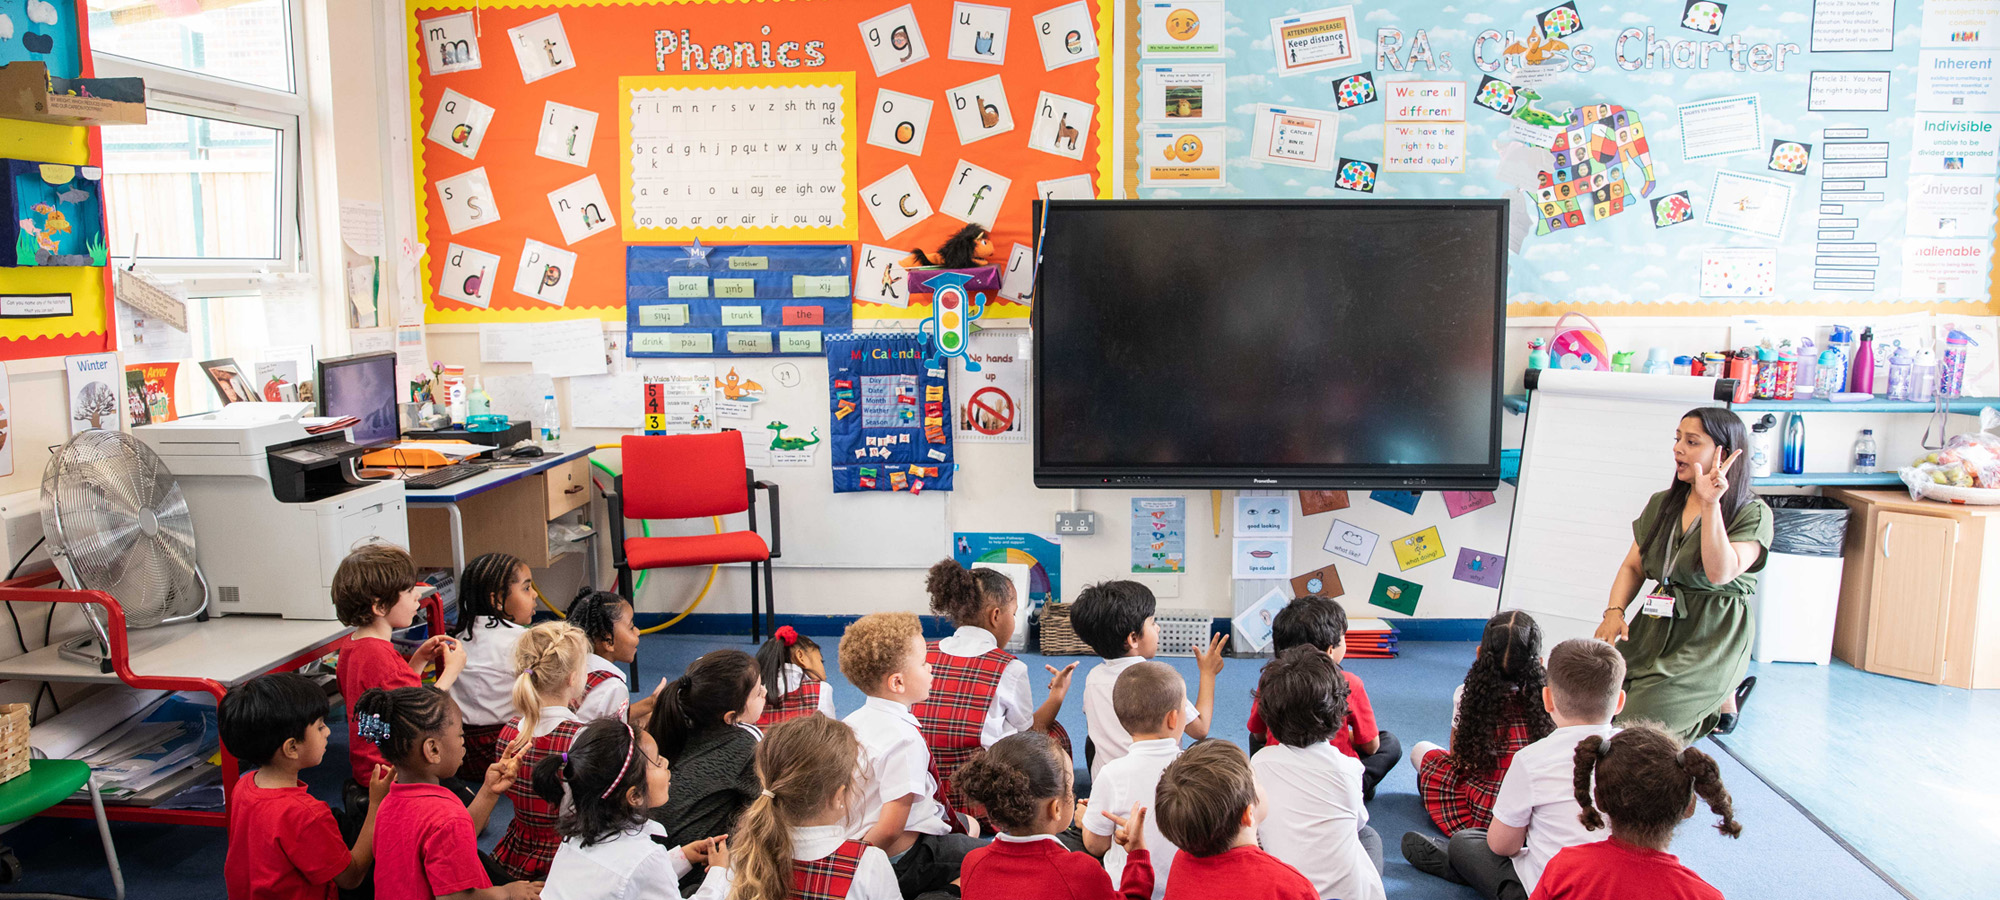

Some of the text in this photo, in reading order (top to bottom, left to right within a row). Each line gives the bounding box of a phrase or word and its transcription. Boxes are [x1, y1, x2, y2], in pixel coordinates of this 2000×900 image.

[959, 11, 971, 26] u
[429, 27, 447, 42] m
[1041, 21, 1052, 35] e
[1287, 22, 1342, 37] ATTENTION PLEASE!
[517, 33, 528, 48] t
[868, 27, 881, 47] g
[1288, 33, 1344, 49] Keep distance
[654, 25, 826, 72] Phonics
[1376, 28, 1453, 72] RAs
[1615, 26, 1800, 72] Charter
[1934, 58, 1992, 70] Inherent
[1853, 75, 1865, 83] You
[1395, 86, 1457, 98] We are all
[1826, 87, 1843, 96] right
[1854, 87, 1870, 96] play
[445, 100, 457, 115] a
[784, 101, 797, 111] sh
[805, 100, 816, 111] th
[822, 101, 836, 114] ng
[882, 100, 893, 114] o
[953, 92, 967, 111] b
[1041, 98, 1053, 119] h
[1399, 105, 1452, 117] different
[549, 108, 556, 126] i
[822, 115, 836, 125] nk
[1289, 128, 1306, 136] CATCH
[1395, 126, 1455, 136] "We have the
[1924, 120, 1993, 133] Indivisible
[636, 141, 837, 156] b c d g h j p qu t w x y ch
[1401, 141, 1448, 152] right to be
[1390, 156, 1423, 164] treated
[1955, 149, 1993, 158] separated
[652, 158, 658, 169] k
[959, 167, 972, 185] f
[444, 186, 453, 201] s
[640, 183, 836, 197] a e i o u ay ee igh ow
[558, 198, 571, 212] n
[871, 193, 881, 207] c
[640, 213, 832, 226] oo oo ar or air ir ou oy
[451, 250, 464, 268] d
[526, 250, 540, 268] p
[691, 248, 706, 260] My
[865, 249, 875, 269] k
[733, 259, 759, 268] brother
[1010, 252, 1024, 273] j
[678, 281, 698, 291] brat
[731, 310, 754, 320] trunk
[796, 310, 812, 319] the
[642, 338, 664, 346] drink
[738, 339, 757, 348] mat
[788, 338, 811, 349] bang
[851, 348, 927, 362] My Calendar
[969, 353, 1014, 363] No hands
[76, 360, 108, 372] Winter
[780, 371, 791, 381] 29
[869, 377, 882, 385] Day
[985, 373, 997, 382] up
[648, 384, 657, 397] 5
[648, 398, 658, 413] 4
[650, 416, 659, 429] 3
[1334, 544, 1361, 558] what like?
[1405, 550, 1439, 566] what doing?
[1469, 574, 1485, 582] why?
